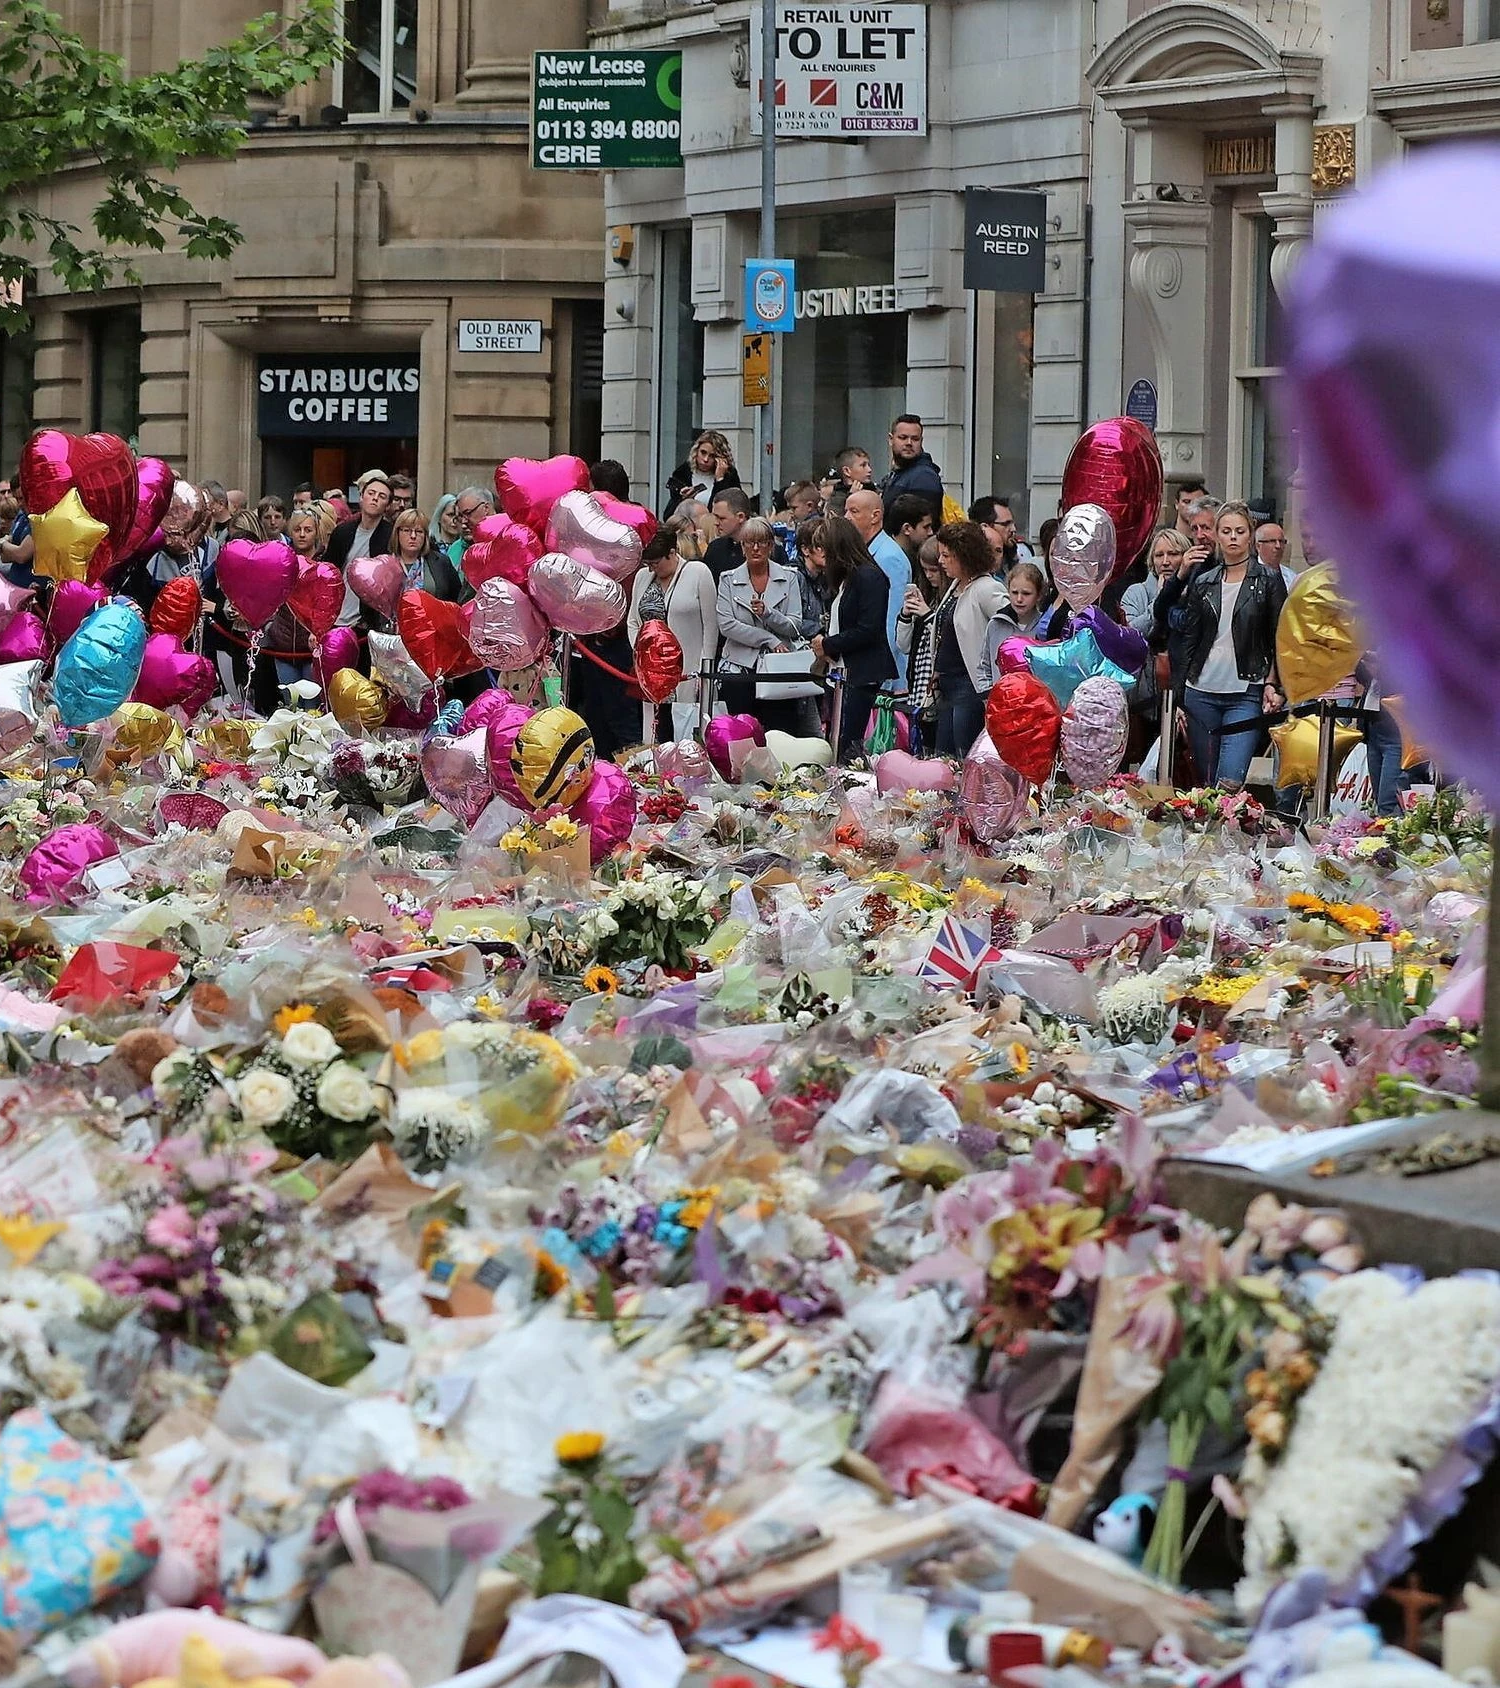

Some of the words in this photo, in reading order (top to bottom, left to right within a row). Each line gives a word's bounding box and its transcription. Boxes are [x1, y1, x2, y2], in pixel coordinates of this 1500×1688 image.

[784, 10, 844, 23] RETAIL
[850, 10, 893, 23] UNIT
[761, 27, 822, 60] TO
[837, 28, 915, 60] LET
[539, 56, 585, 74] New
[590, 56, 646, 74] Lease
[800, 64, 819, 72] ALL
[822, 64, 876, 73] ENQUIRIES
[538, 78, 568, 88] (Subject
[569, 78, 577, 87] to
[578, 79, 603, 87] vacant
[604, 78, 646, 88] possession)
[856, 82, 904, 110] C&M
[538, 98, 554, 111] All
[557, 98, 611, 113] Enquiries
[808, 111, 817, 119] &
[537, 120, 587, 139] 0113
[591, 120, 627, 139] 394
[631, 120, 680, 139] 8800
[845, 119, 868, 130] 0161
[870, 119, 888, 130] 832
[890, 119, 914, 130] 3375
[539, 145, 602, 164] CBRE
[975, 223, 1039, 239] AUSTIN
[983, 240, 1030, 256] REED
[794, 287, 855, 319] USTIN
[467, 323, 492, 335] OLD
[497, 323, 533, 335] BANK
[475, 336, 523, 349] STREET
[259, 368, 419, 393] STARBUCKS
[288, 397, 388, 422] COFFEE
